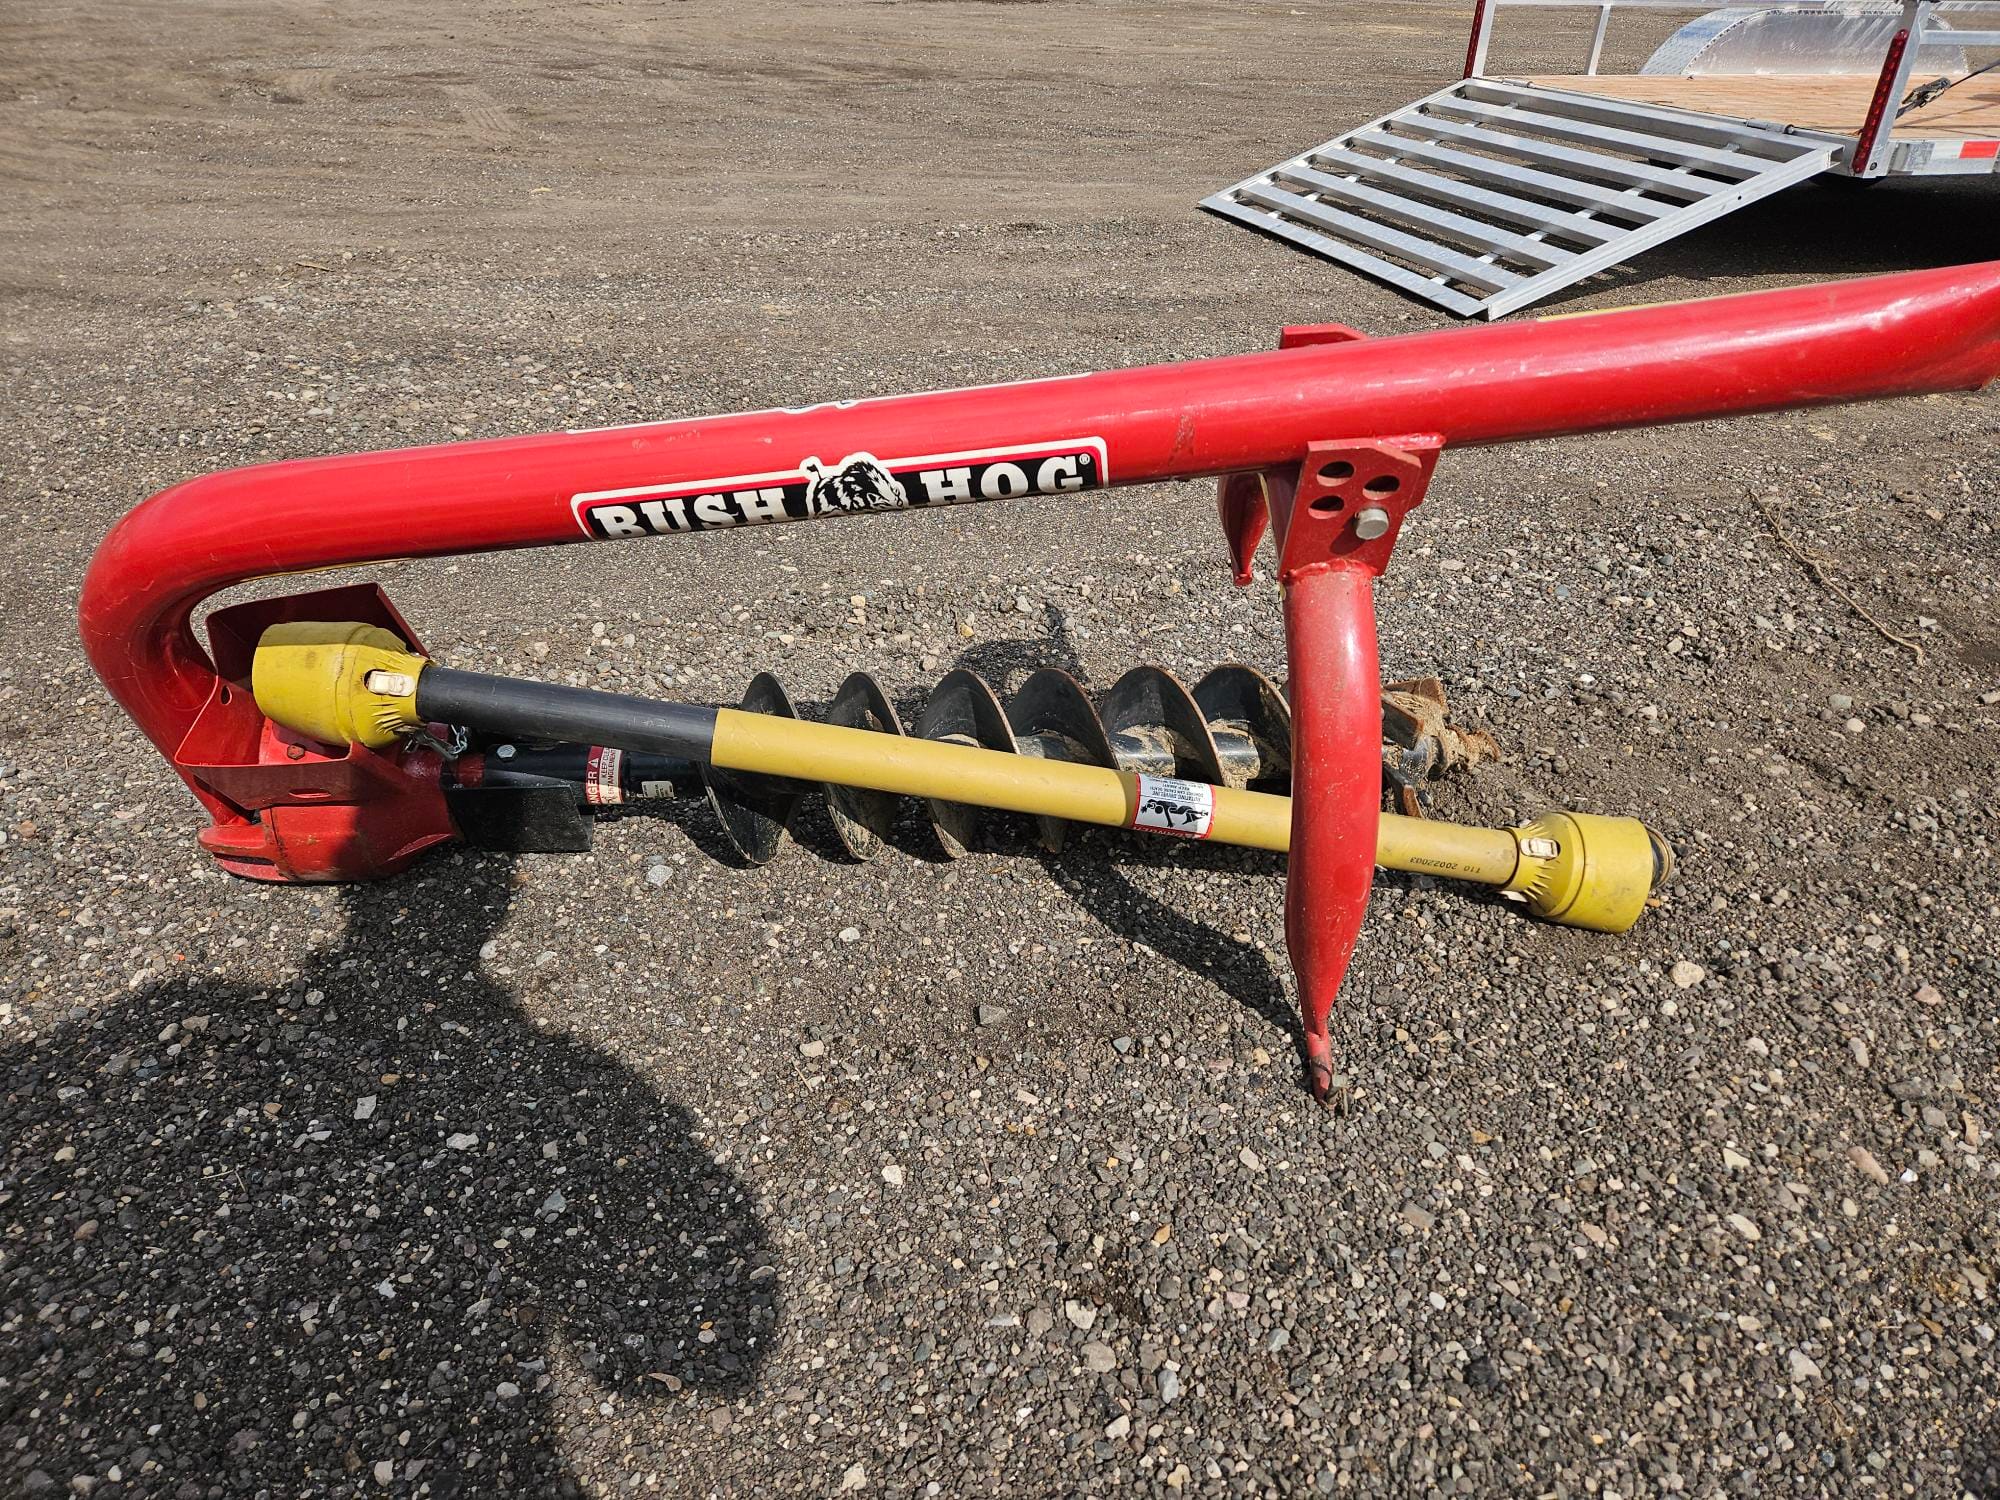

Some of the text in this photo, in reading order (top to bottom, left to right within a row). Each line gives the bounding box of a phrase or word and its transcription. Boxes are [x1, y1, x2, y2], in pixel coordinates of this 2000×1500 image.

[592, 488, 793, 540] BUSH
[587, 771, 600, 804] ANGER
[1409, 857, 1458, 870] 20022003
